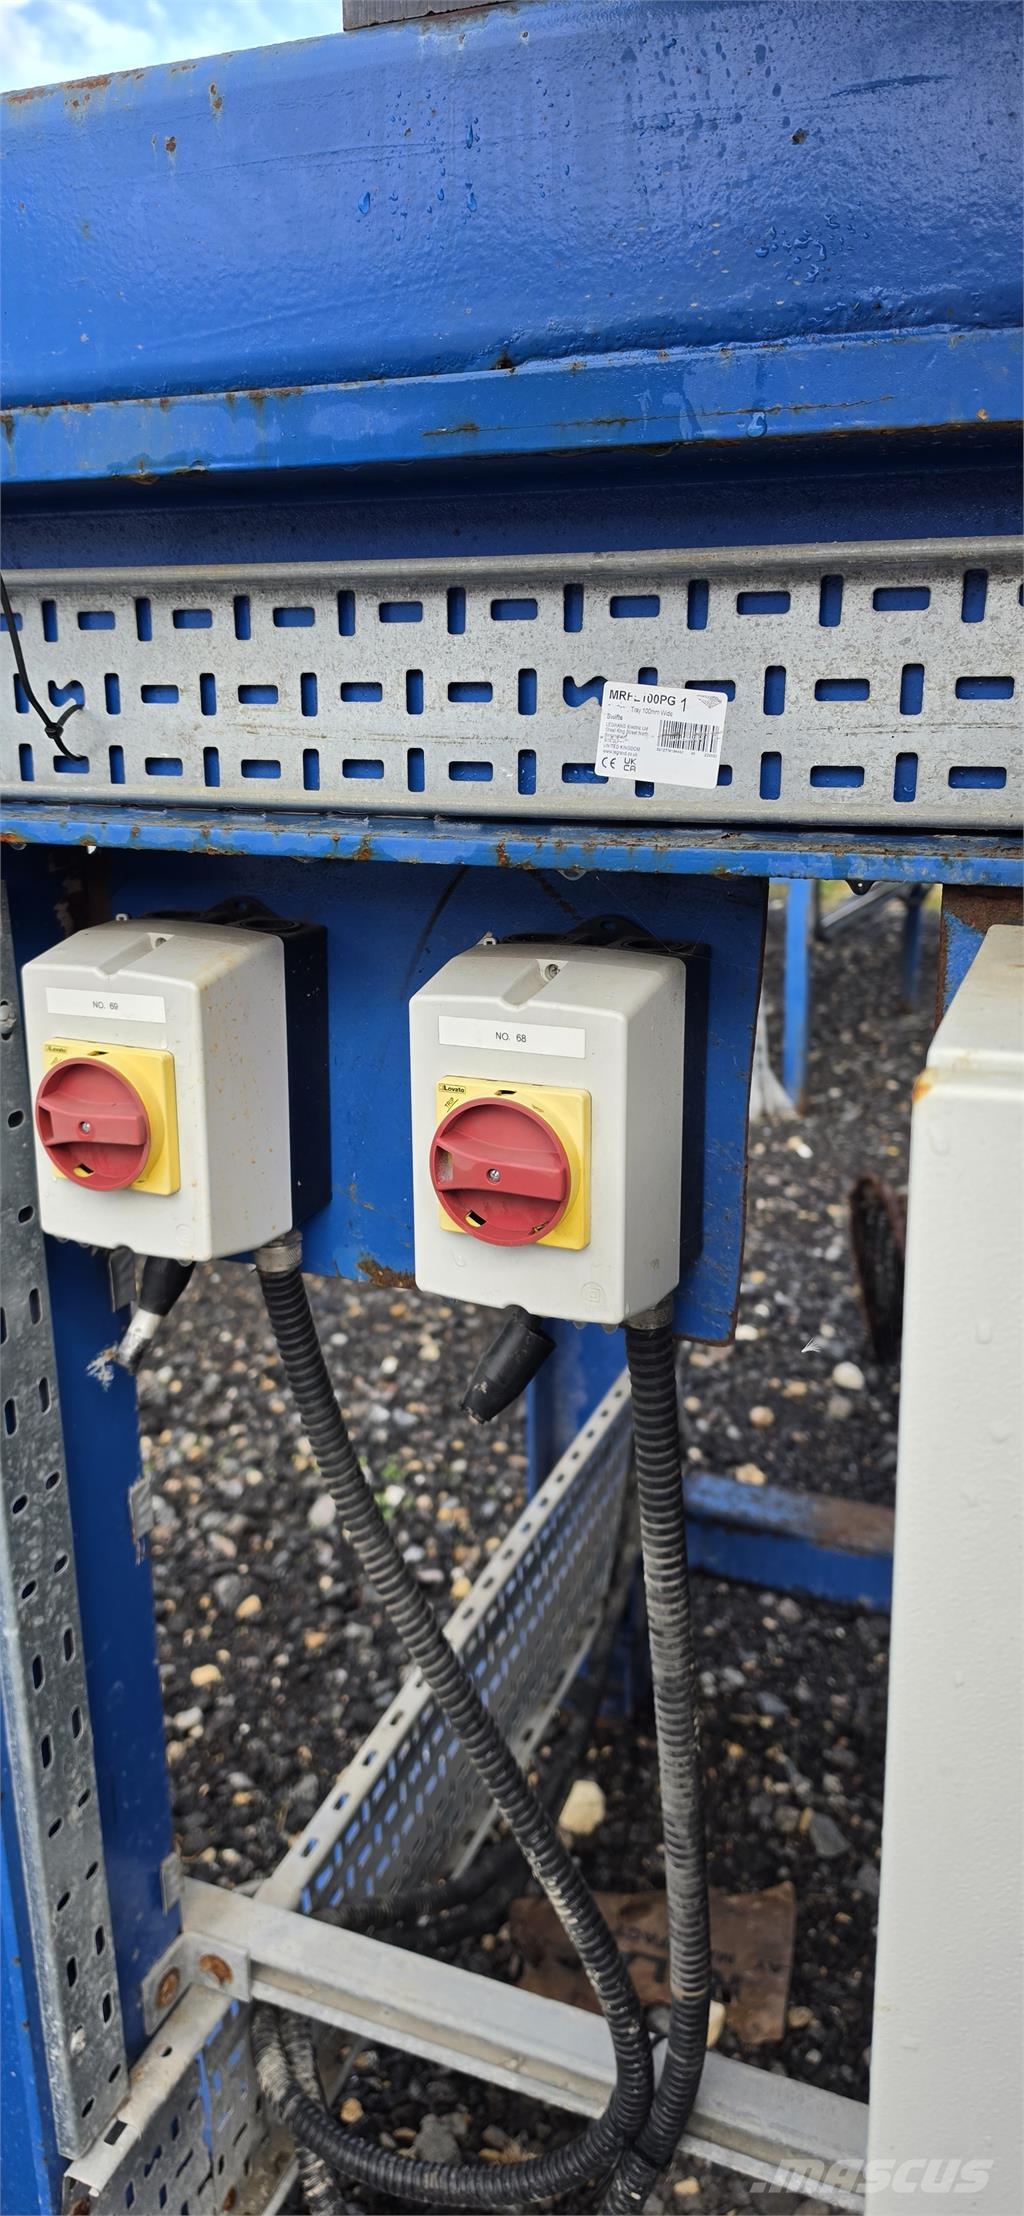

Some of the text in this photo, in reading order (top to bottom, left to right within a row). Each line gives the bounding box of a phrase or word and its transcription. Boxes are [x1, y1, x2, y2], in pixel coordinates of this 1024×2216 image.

[680, 697, 688, 712] 1
[495, 1032, 527, 1043] NO. 68
[443, 1084, 465, 1093] Lovato
